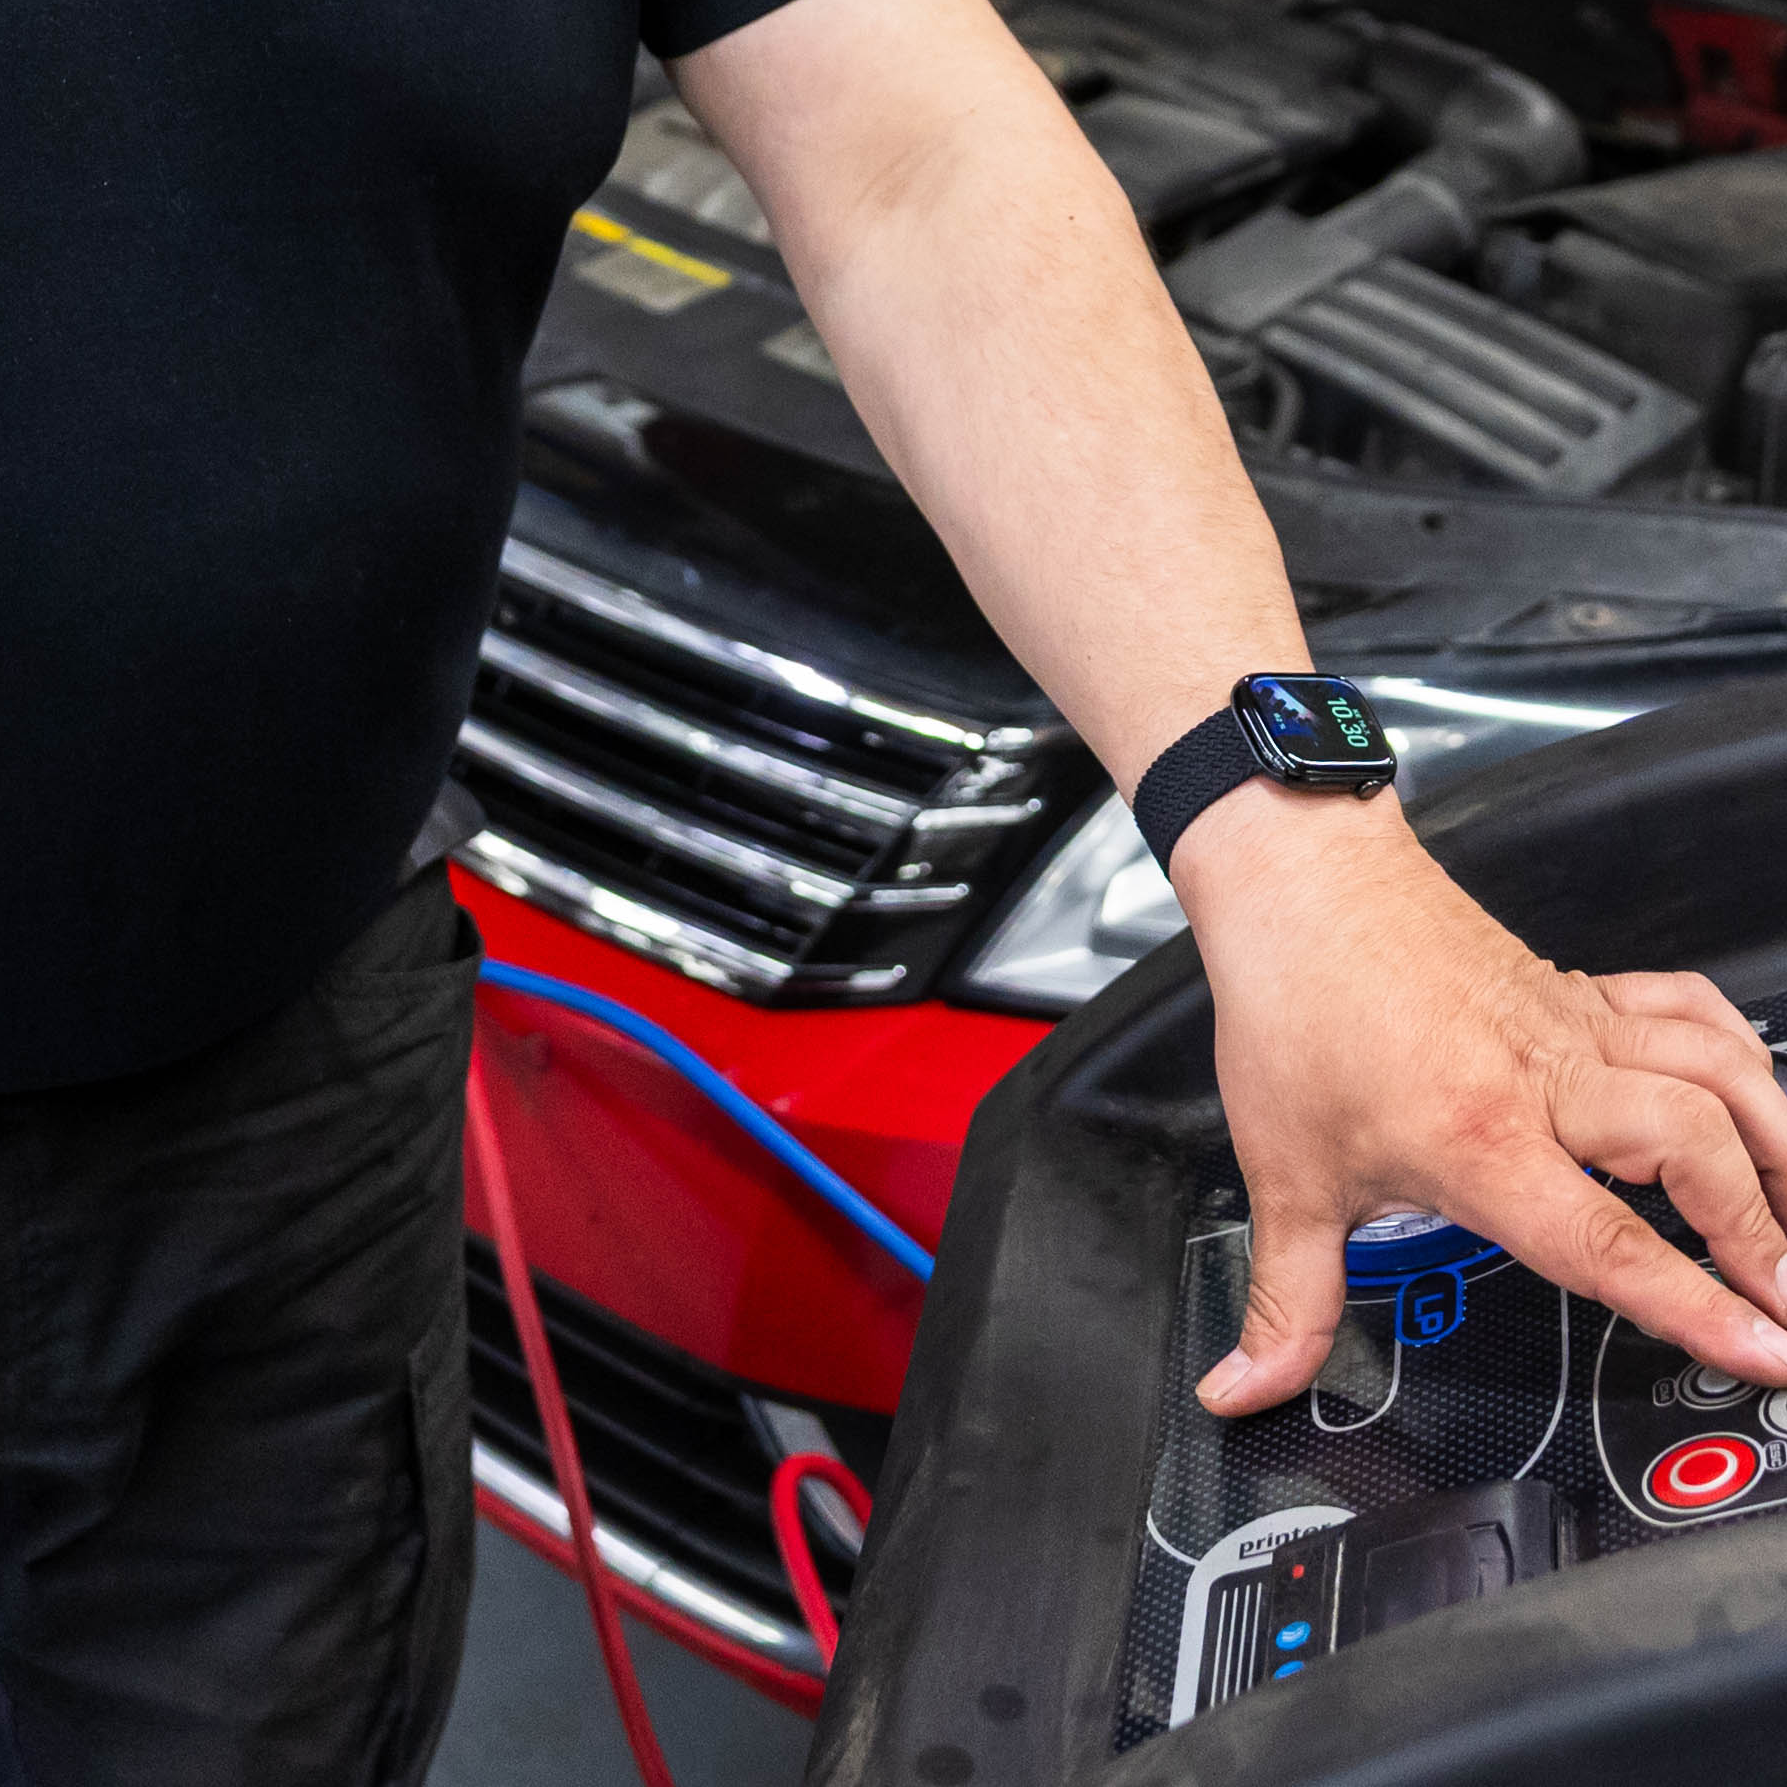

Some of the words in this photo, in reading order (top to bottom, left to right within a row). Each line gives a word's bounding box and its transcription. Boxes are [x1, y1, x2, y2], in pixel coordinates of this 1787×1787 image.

[1327, 697, 1369, 748] 10.30
[1414, 1293, 1445, 1335] LP
[1768, 1443, 1783, 1468] ESC
